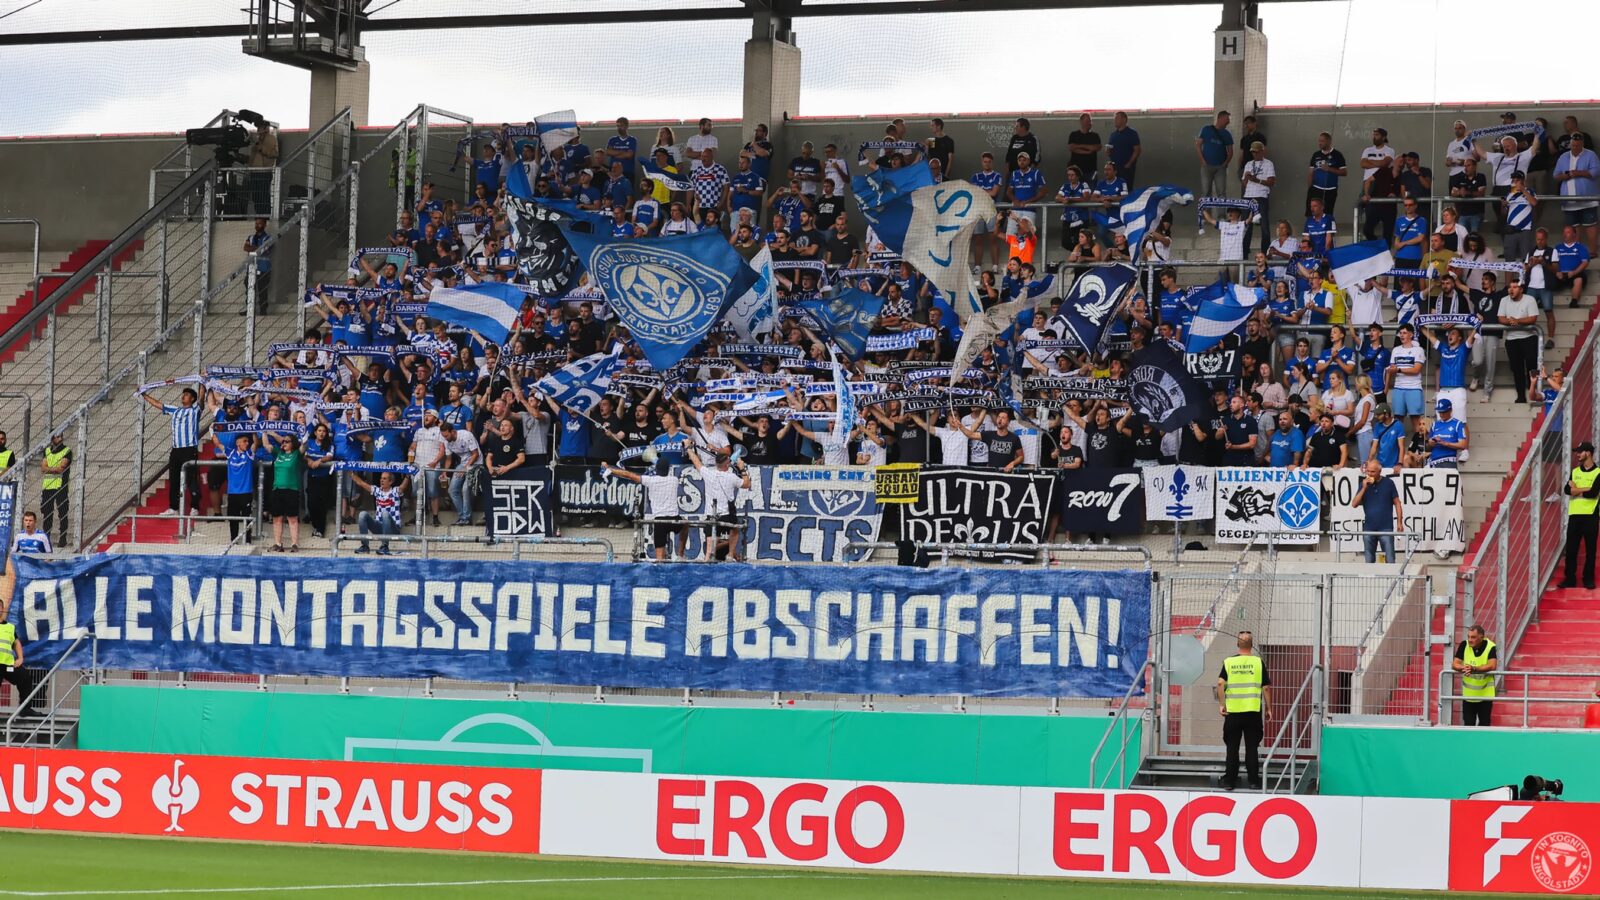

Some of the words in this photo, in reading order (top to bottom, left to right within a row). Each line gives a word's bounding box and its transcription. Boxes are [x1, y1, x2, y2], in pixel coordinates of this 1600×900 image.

[1222, 36, 1237, 55] H
[612, 298, 696, 336] DARMSTADT
[1420, 315, 1468, 323] DARMSTADT
[1470, 316, 1479, 324] 98
[753, 346, 794, 354] SUSPECTS
[1224, 351, 1235, 372] 7
[227, 423, 244, 431] DA
[245, 423, 256, 431] ist
[259, 421, 295, 431] Vielfalt
[876, 473, 919, 484] URBAN
[876, 483, 918, 495] SQUAD
[560, 469, 642, 516] underdogs
[23, 576, 154, 642] ALLE
[171, 576, 670, 659] MONTAGSSPIELE
[685, 586, 1122, 669] ABSCHAFFEN!
[229, 772, 513, 837] STRAUSS
[656, 778, 905, 864] ERGO
[1053, 791, 1318, 879] ERGO
